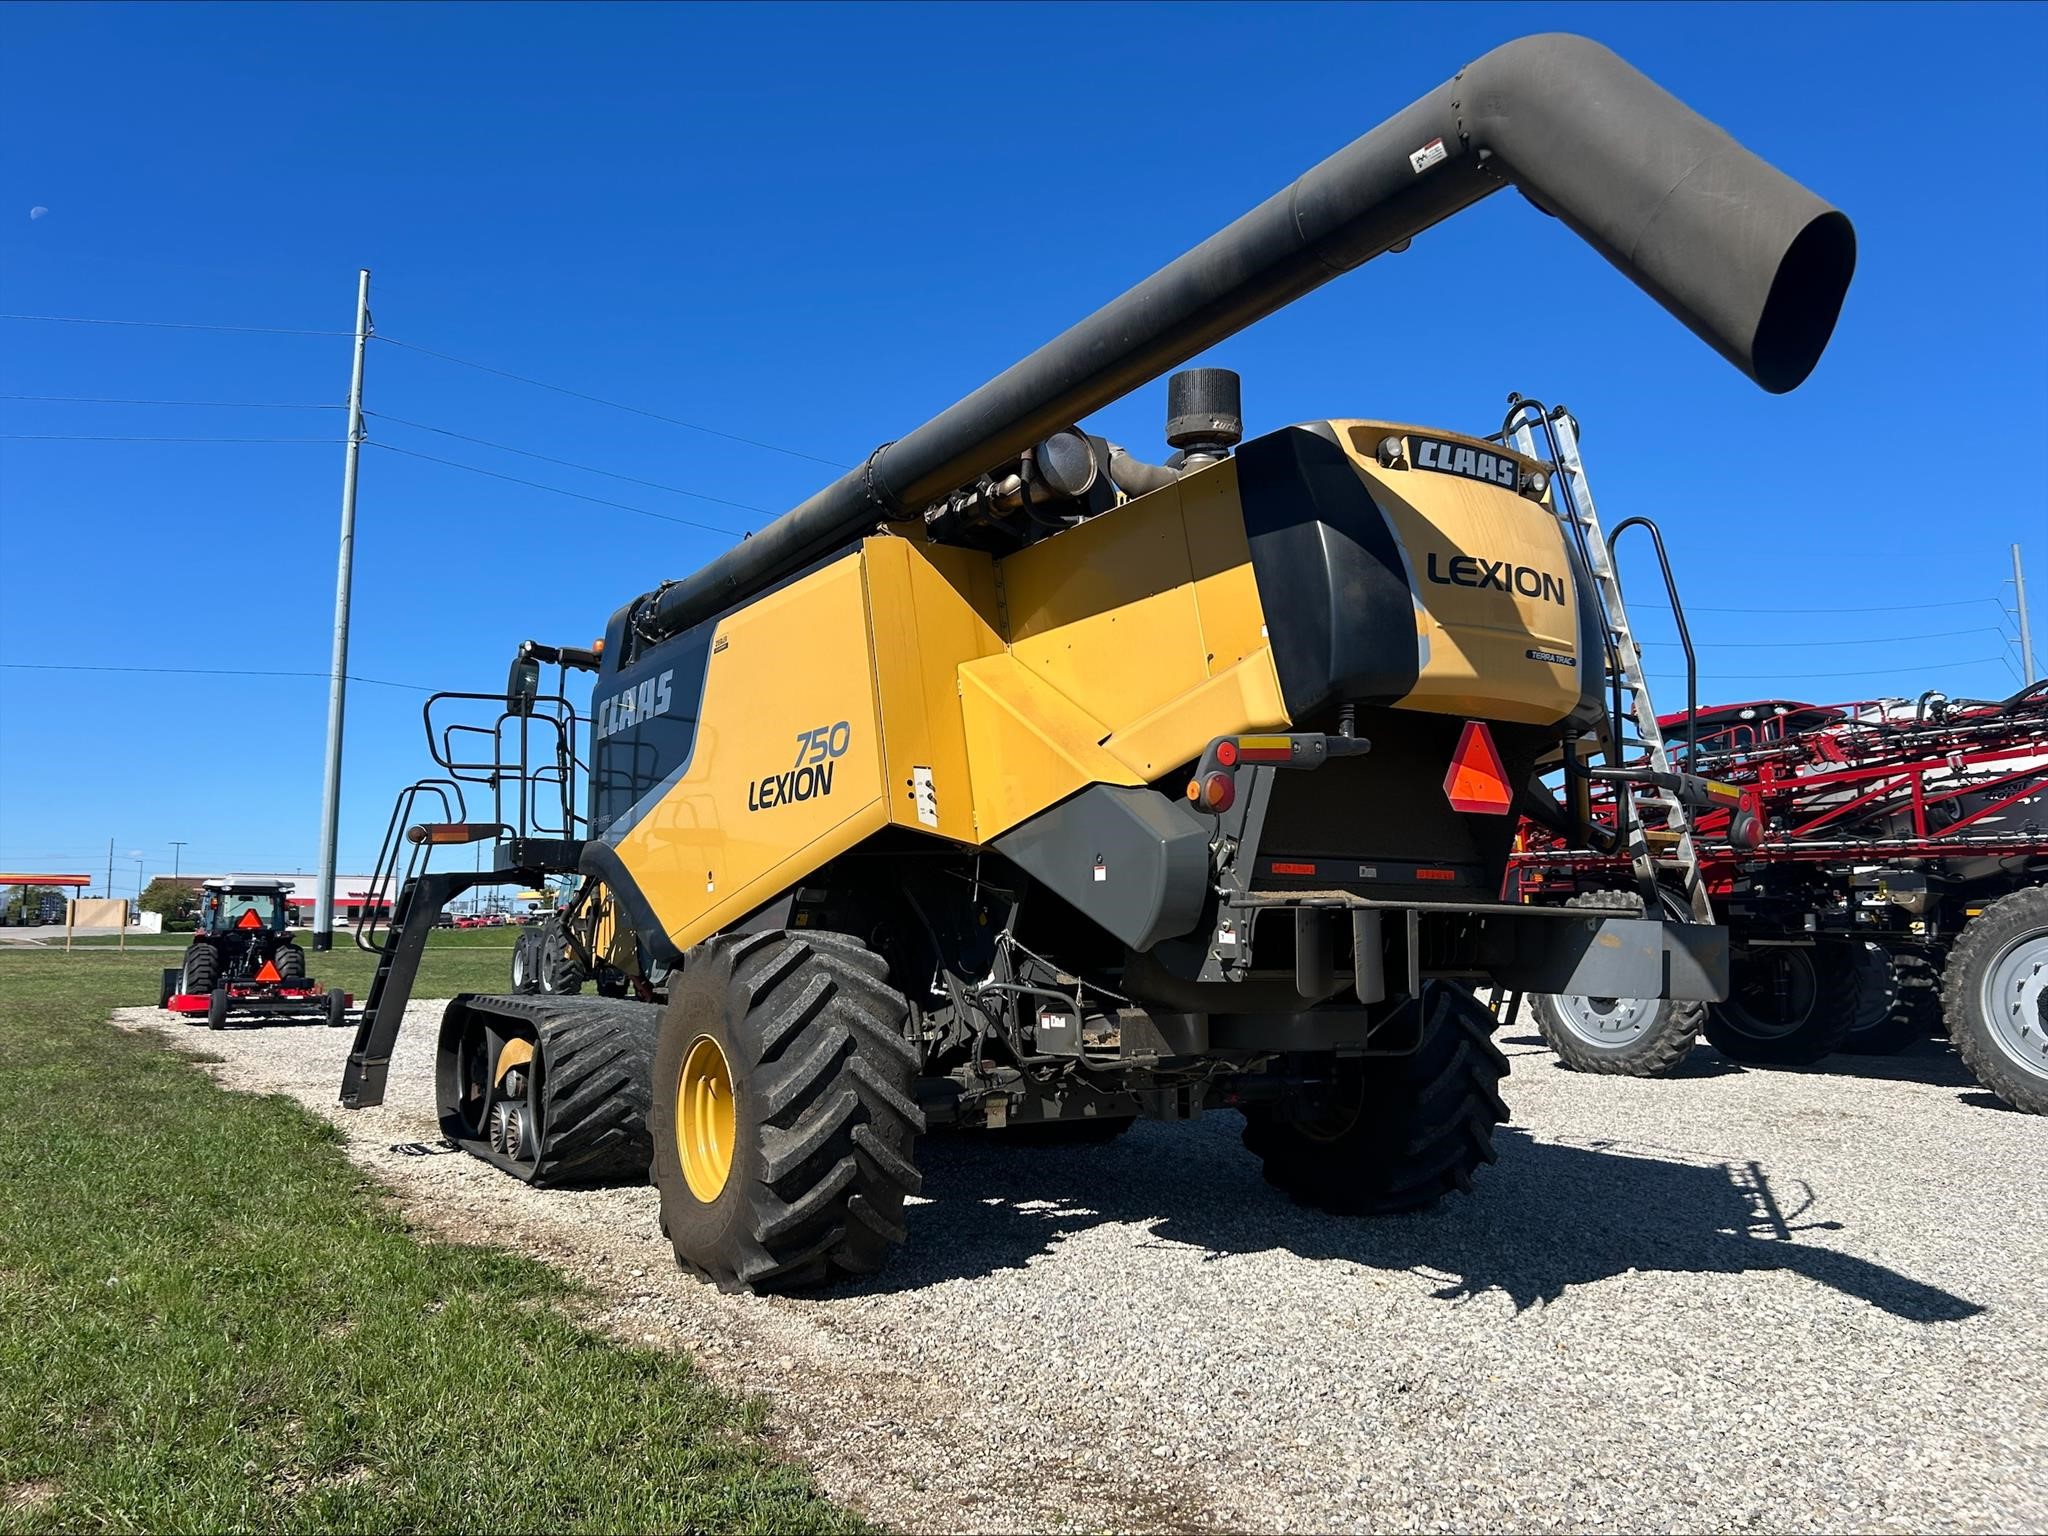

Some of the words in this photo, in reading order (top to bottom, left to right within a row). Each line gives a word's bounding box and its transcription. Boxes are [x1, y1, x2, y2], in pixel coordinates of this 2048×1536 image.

[1418, 441, 1513, 486] CLAAS
[1427, 552, 1566, 606] LEXION
[1531, 651, 1555, 662] TERRA
[1556, 655, 1573, 665] TRAC
[597, 668, 674, 740] CLAAS
[794, 720, 851, 768] 750
[748, 760, 834, 812] LEXION
